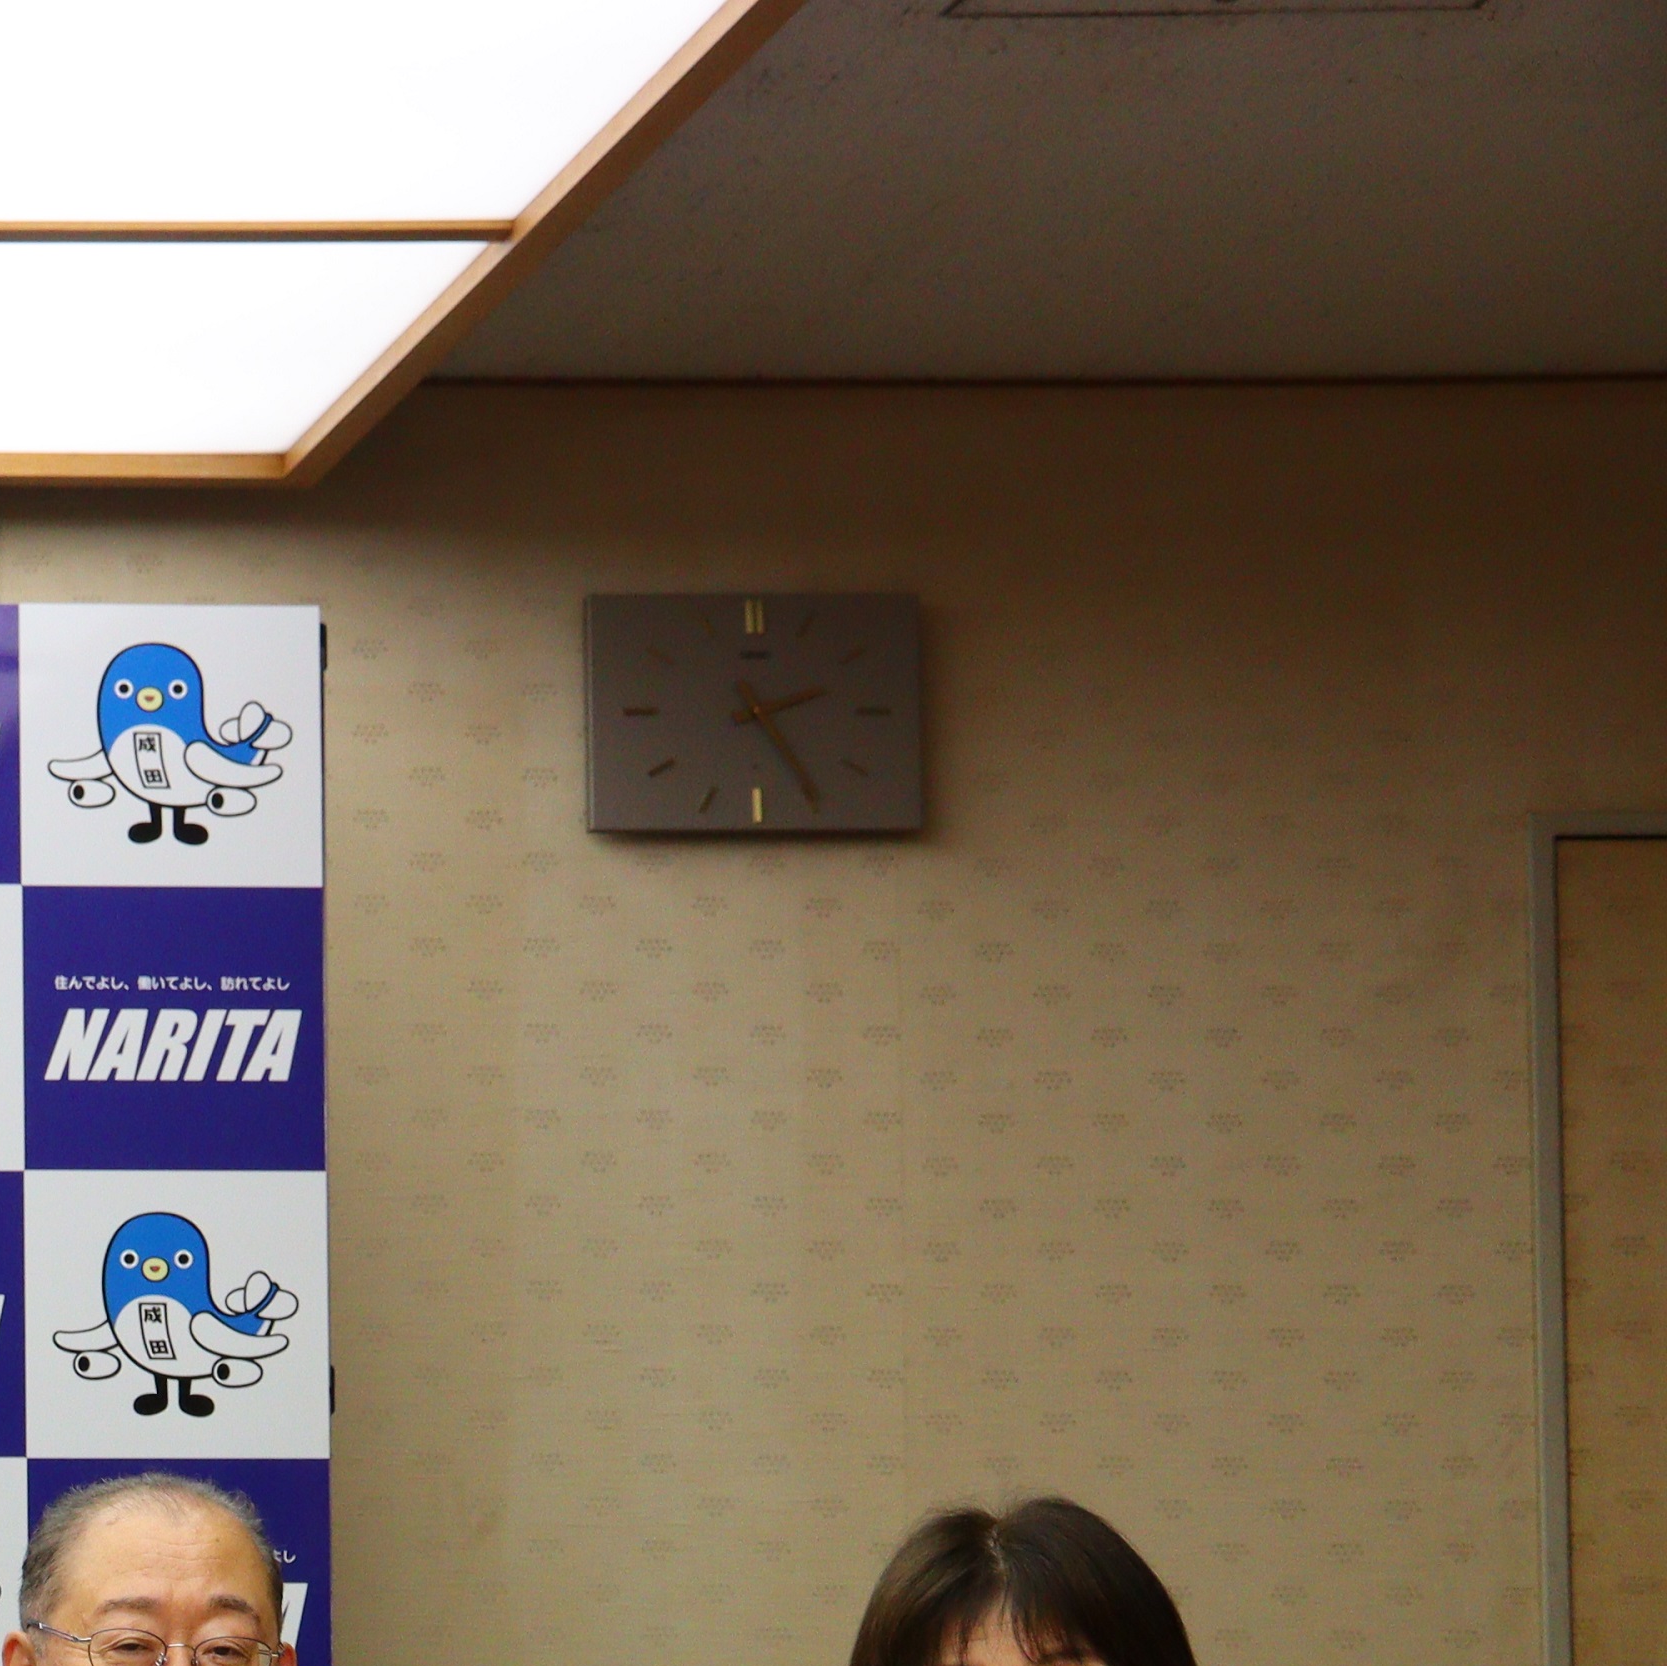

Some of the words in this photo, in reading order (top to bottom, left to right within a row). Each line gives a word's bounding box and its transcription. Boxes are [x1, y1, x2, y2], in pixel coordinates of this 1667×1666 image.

[138, 736, 163, 784] 成田
[53, 974, 291, 992] 住んでよし、働いてよし、訪れてよし
[45, 1009, 301, 1081] NARITA
[143, 1306, 170, 1356] 成田
